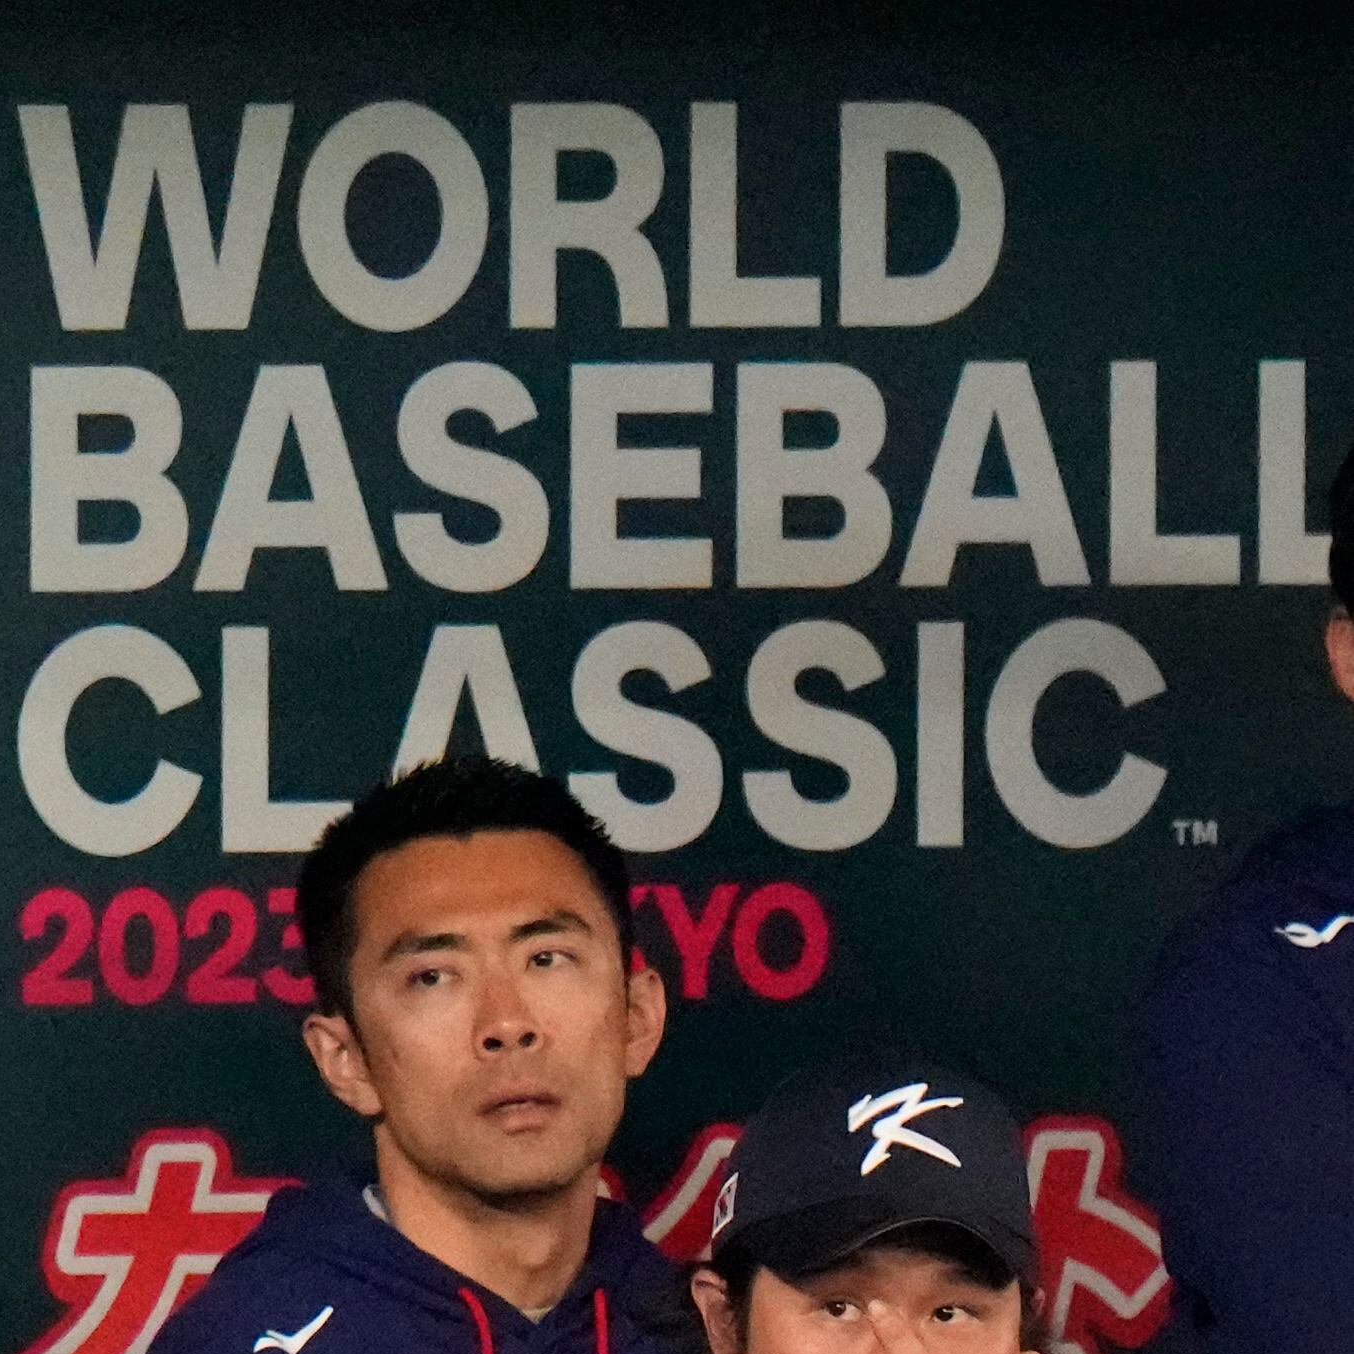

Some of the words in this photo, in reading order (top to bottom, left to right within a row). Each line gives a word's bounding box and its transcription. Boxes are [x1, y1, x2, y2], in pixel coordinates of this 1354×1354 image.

[17, 100, 1007, 333] WORLD
[28, 359, 1334, 594] BASEBALL
[16, 617, 1170, 857] CLASSIC
